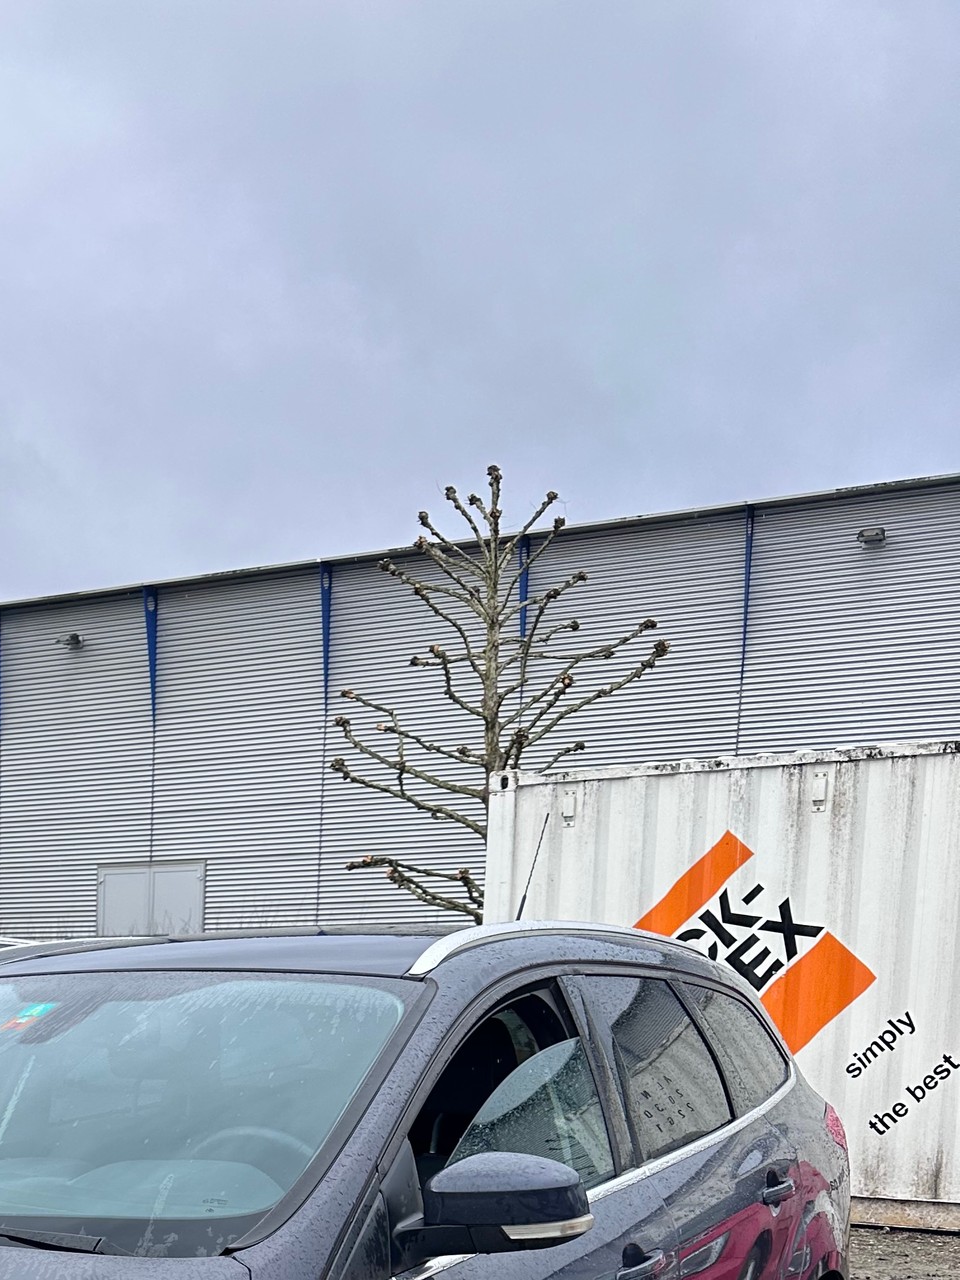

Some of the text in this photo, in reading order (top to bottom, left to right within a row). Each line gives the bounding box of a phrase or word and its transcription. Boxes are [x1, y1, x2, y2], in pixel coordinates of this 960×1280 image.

[846, 1011, 916, 1079] simply
[868, 1054, 960, 1136] the best
